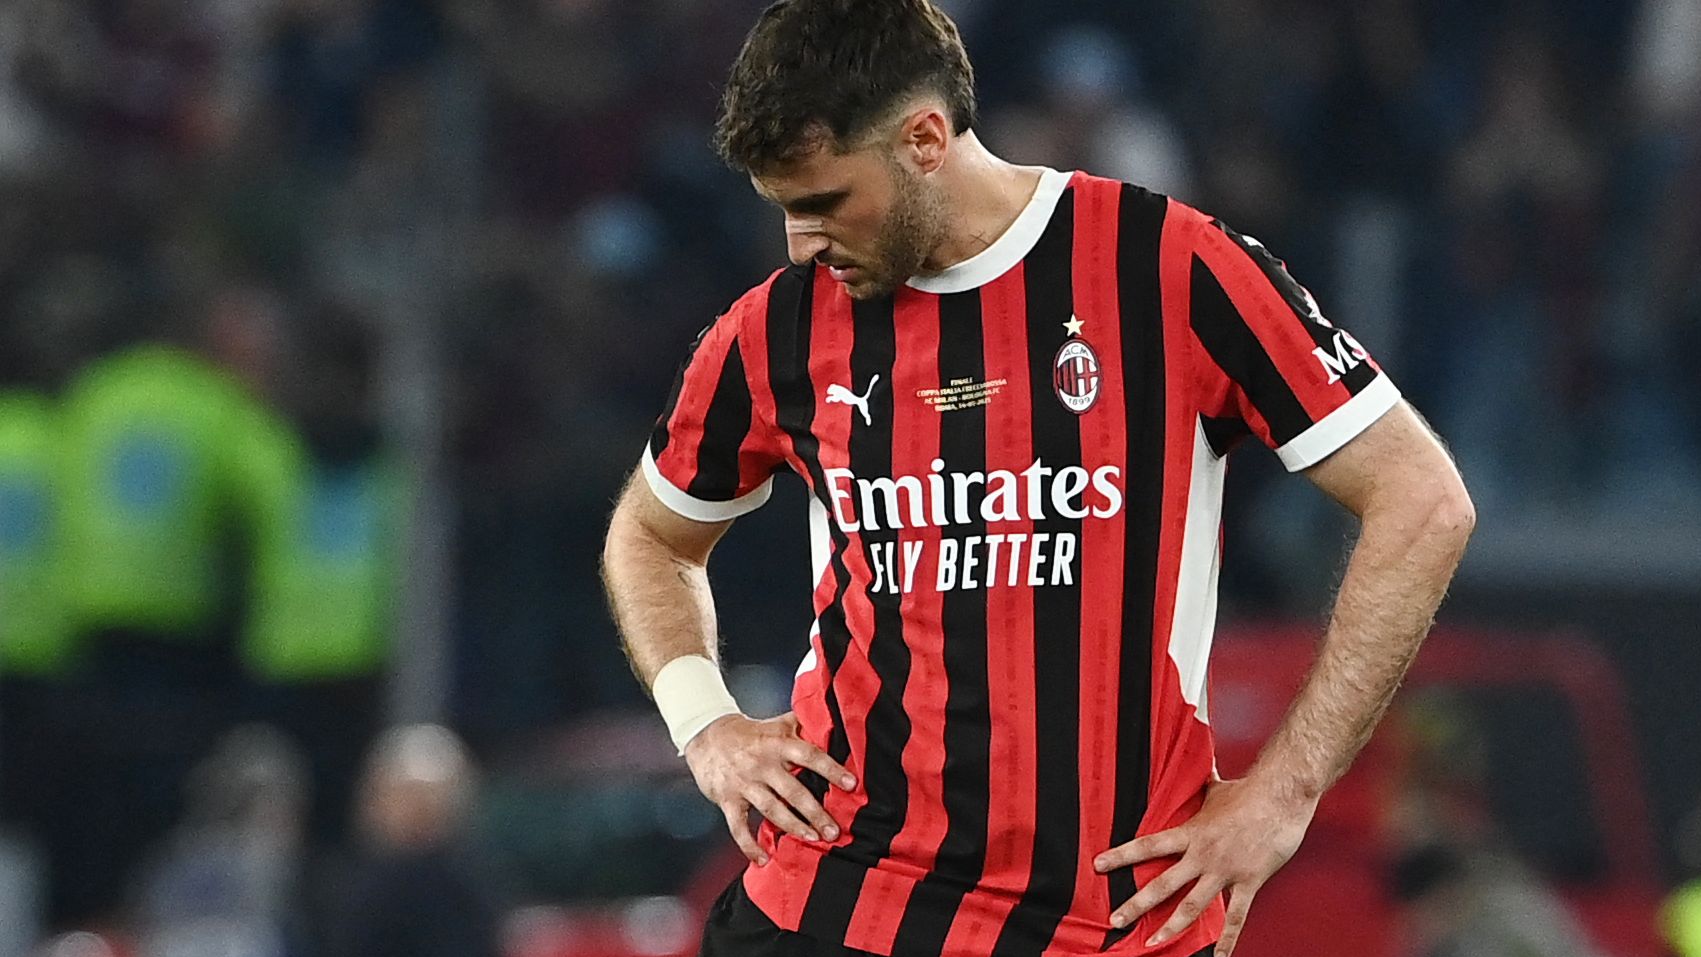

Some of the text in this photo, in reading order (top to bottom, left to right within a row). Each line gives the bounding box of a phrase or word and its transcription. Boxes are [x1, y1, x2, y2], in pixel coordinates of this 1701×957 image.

[1063, 345, 1089, 360] ACM
[1068, 396, 1091, 405] 1899
[825, 456, 1123, 533] Emirates
[870, 532, 1077, 594] FLY BETTER
